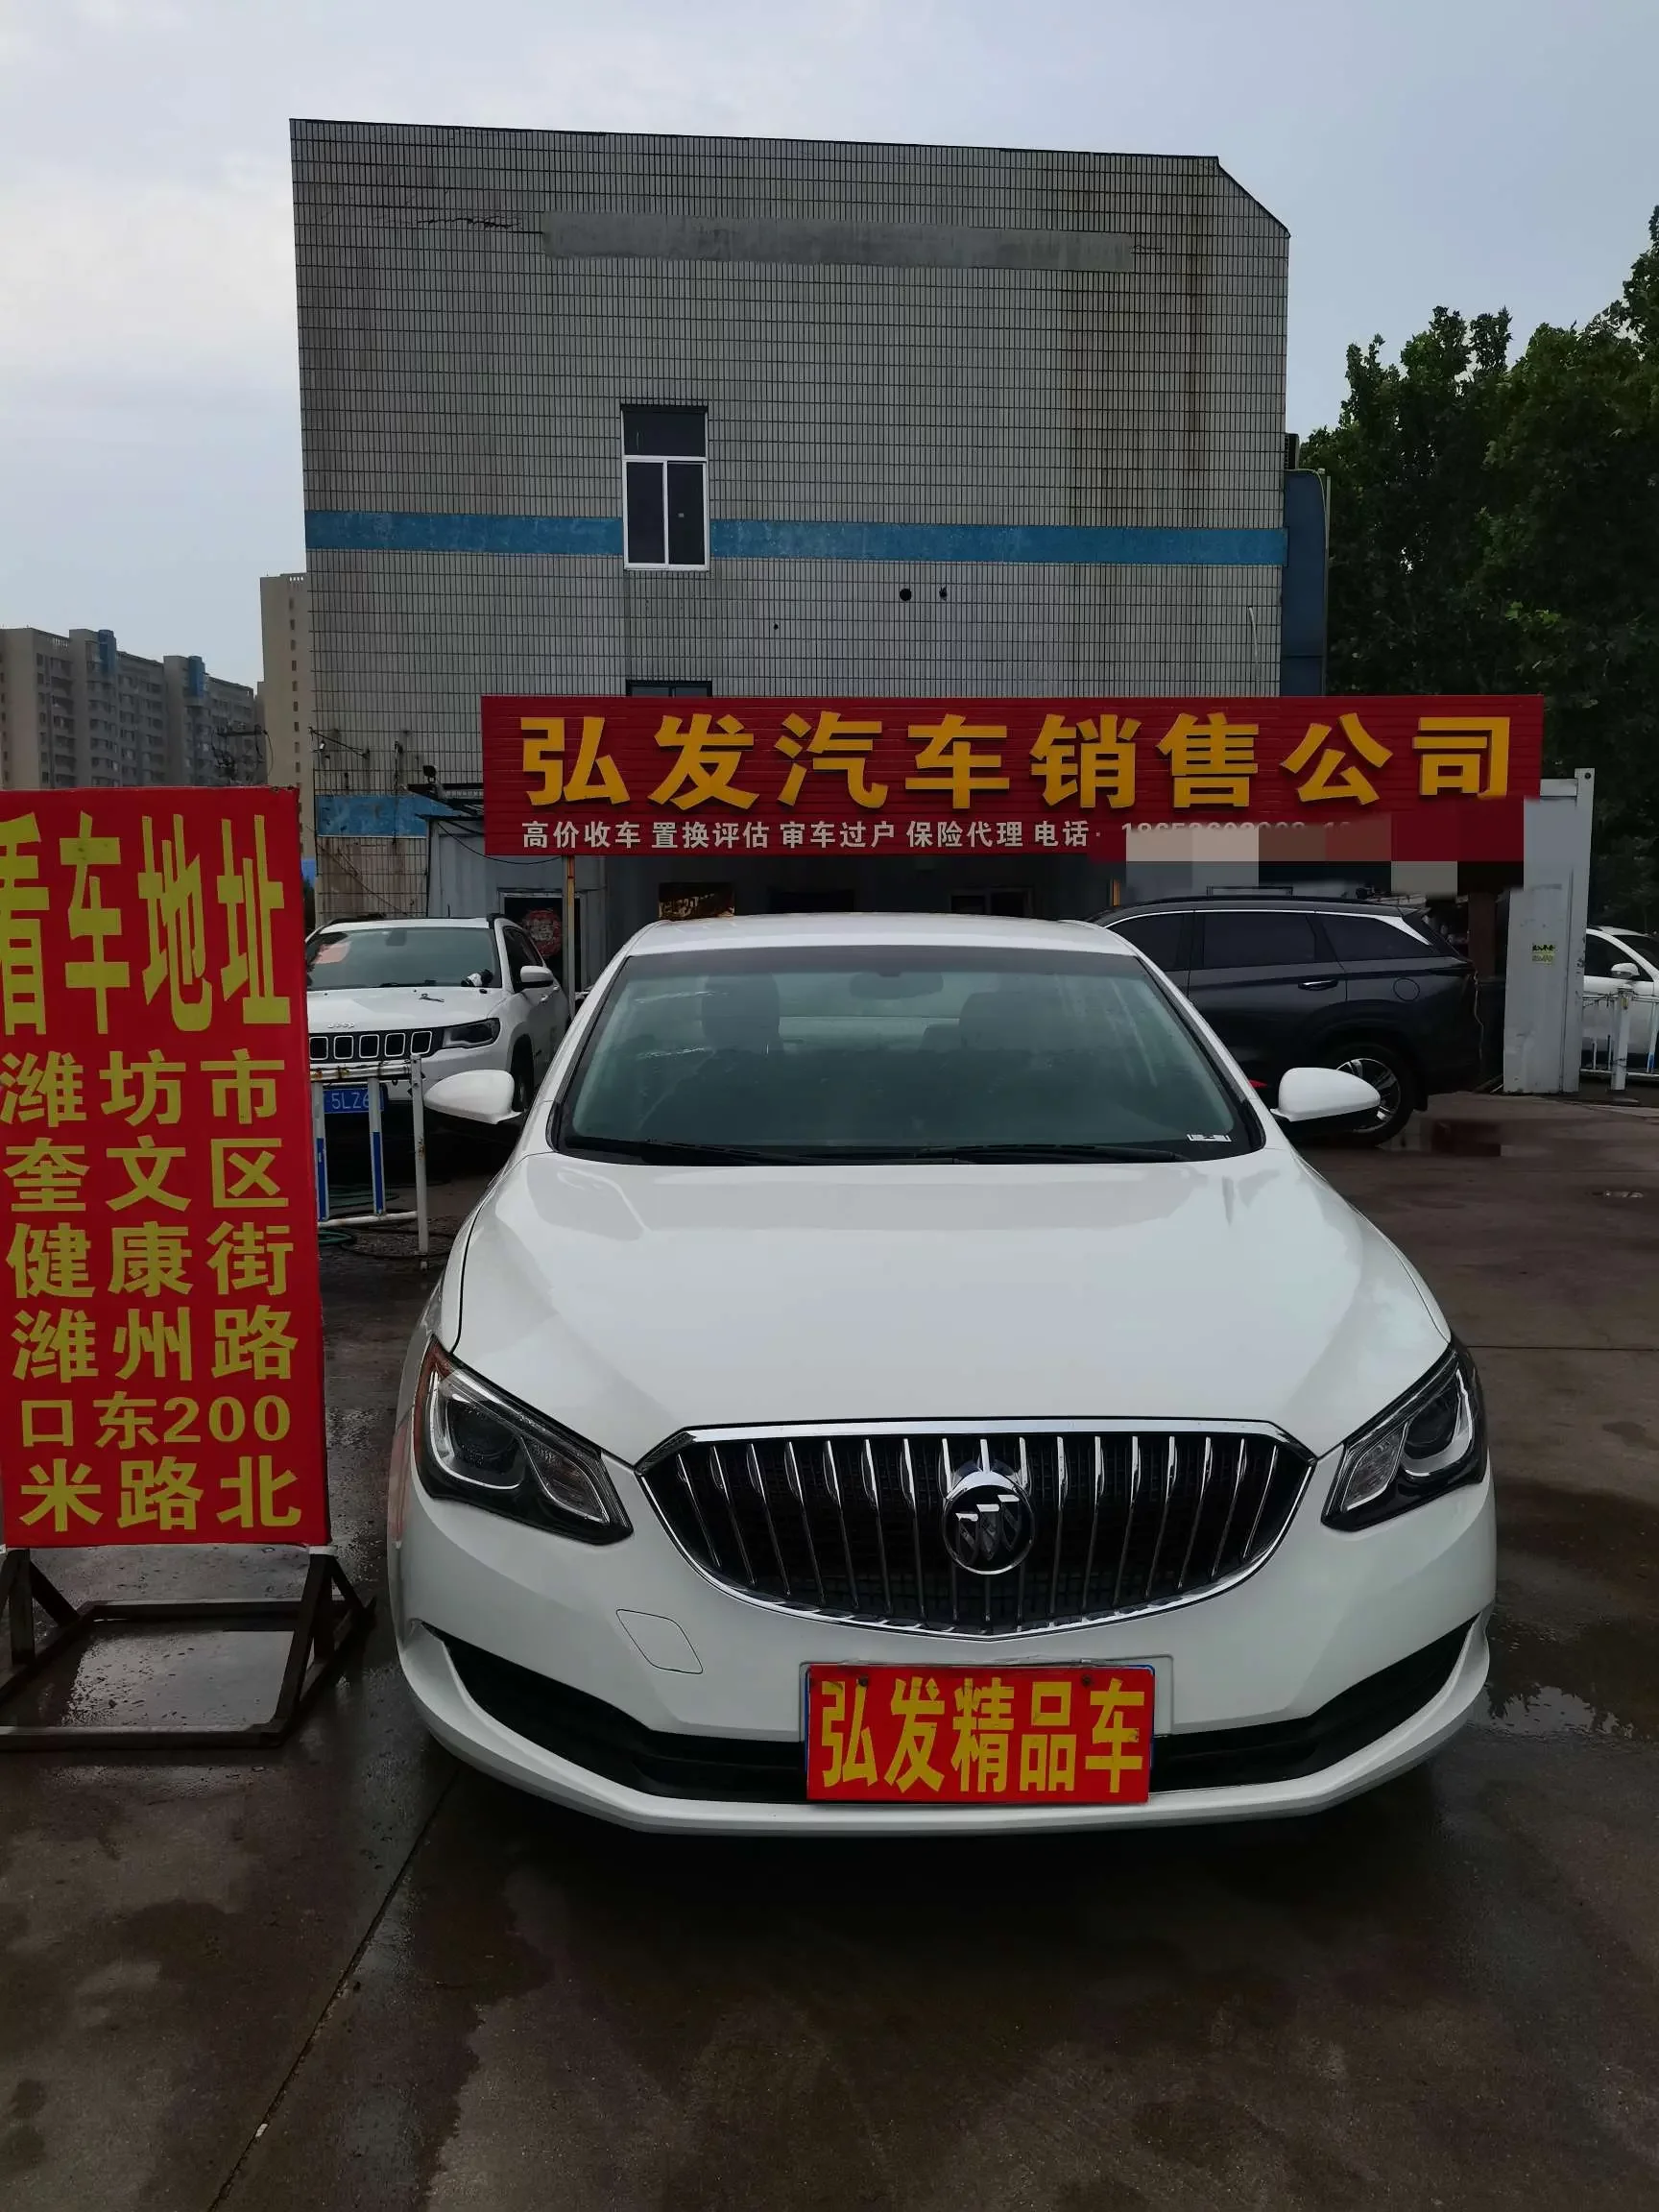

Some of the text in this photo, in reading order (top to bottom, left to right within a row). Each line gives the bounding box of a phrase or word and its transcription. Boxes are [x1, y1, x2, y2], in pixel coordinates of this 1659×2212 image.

[521, 711, 1509, 809] 弘发汽车销售公司
[522, 821, 640, 848] 高价收车
[652, 822, 769, 848] 置换评估
[781, 821, 894, 848] 审车过户
[906, 821, 1022, 847] 保险代理
[0, 1049, 283, 1127] 潍坊市
[4, 1137, 288, 1212] 奎文区
[7, 1221, 293, 1298] 健康街
[12, 1306, 297, 1382] 潍州路
[22, 1391, 289, 1449] 口东200
[21, 1455, 300, 1532] 米路北
[822, 1678, 1143, 1792] 弘发精品车
